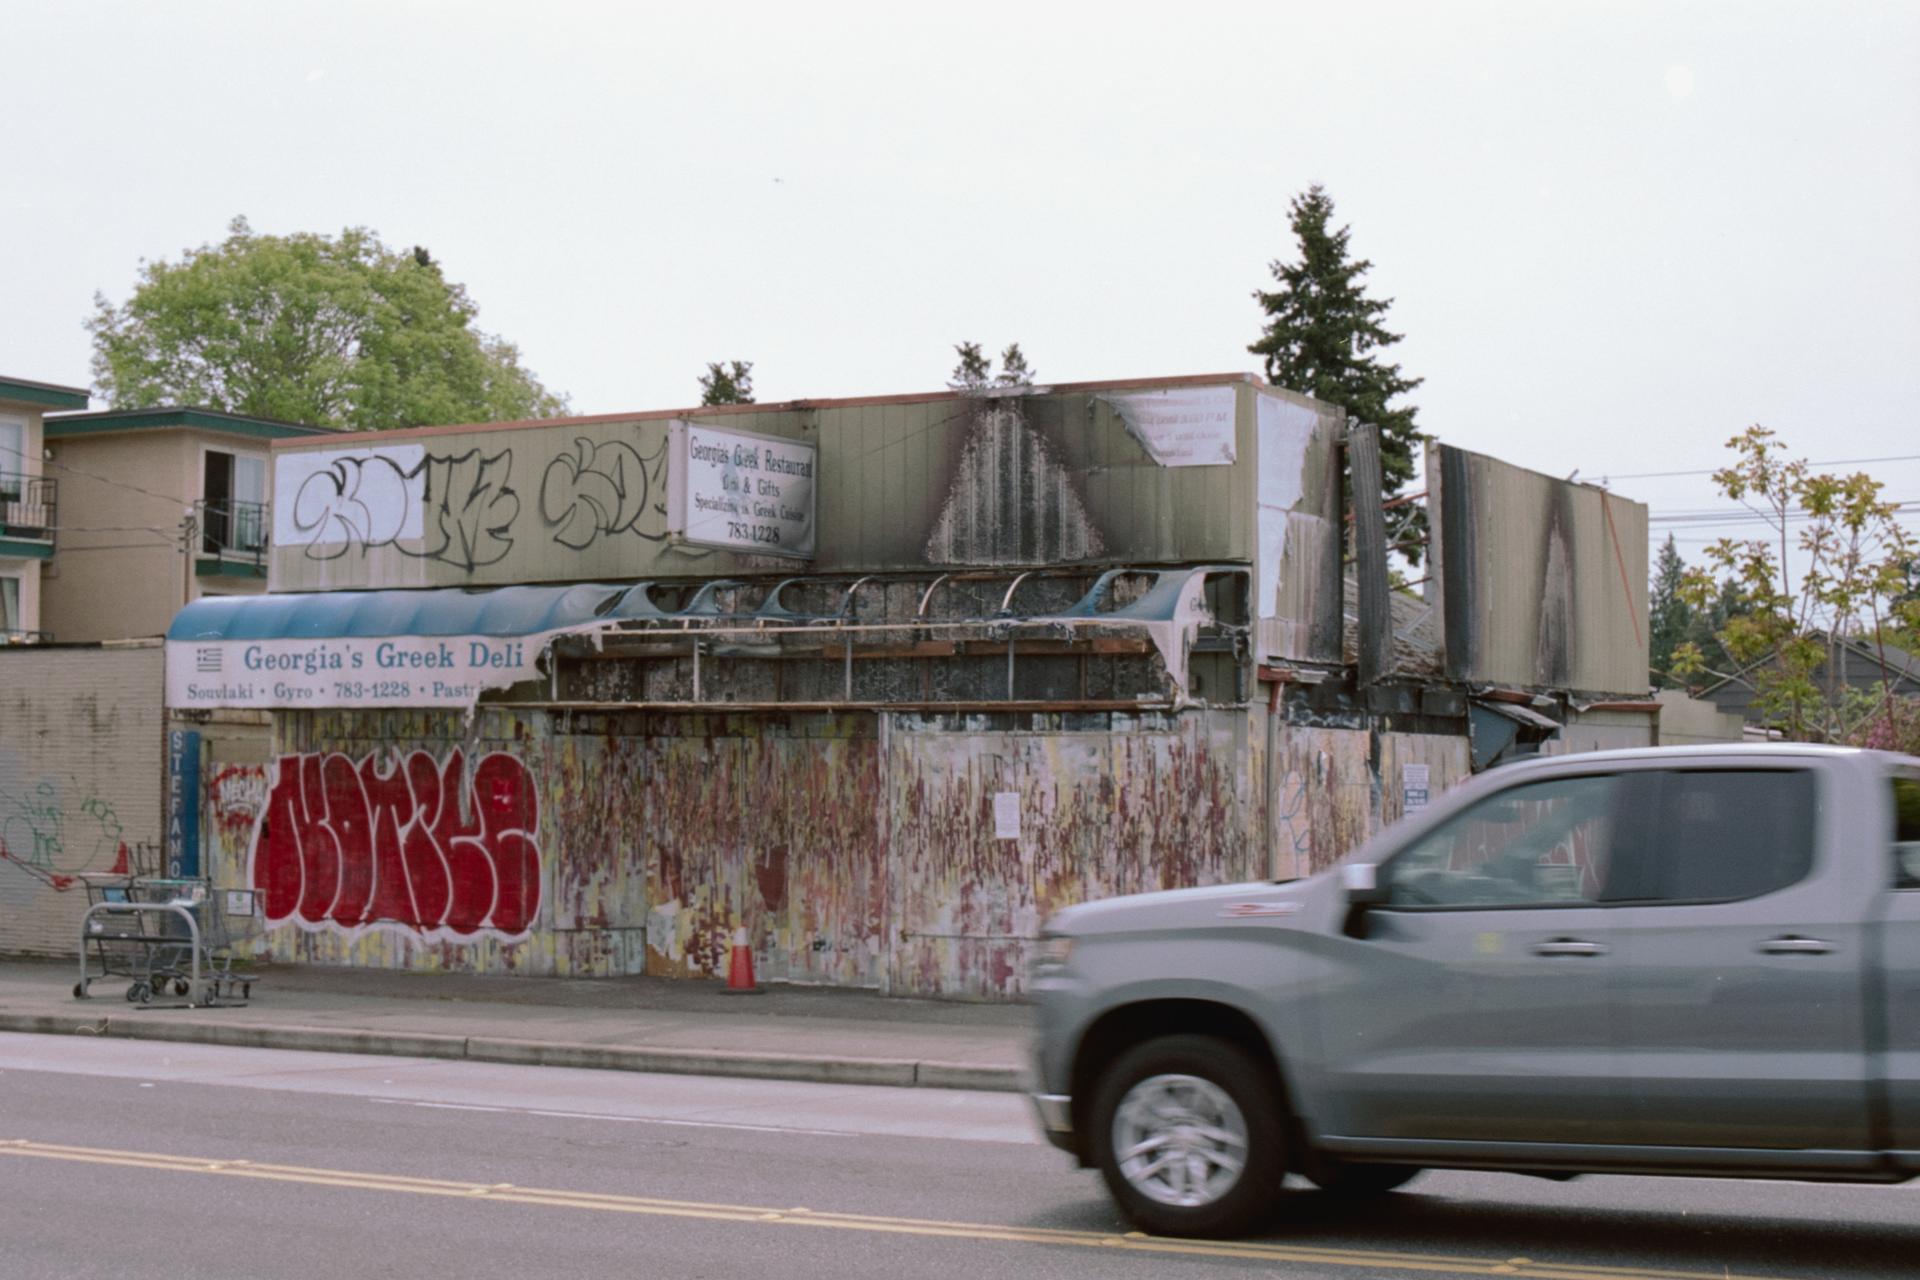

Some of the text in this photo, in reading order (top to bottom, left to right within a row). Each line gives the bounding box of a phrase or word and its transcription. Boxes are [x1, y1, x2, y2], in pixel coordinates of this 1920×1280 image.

[765, 449, 813, 478] Restauran
[743, 476, 751, 494] &
[757, 478, 780, 497] Gifts
[753, 501, 776, 518] Greek
[244, 641, 524, 675] Georgia's Greek Deli
[187, 683, 253, 699] Souvlaki
[273, 682, 313, 701] Gyro
[333, 681, 411, 698] 783-1228
[171, 730, 183, 878] STEFANO
